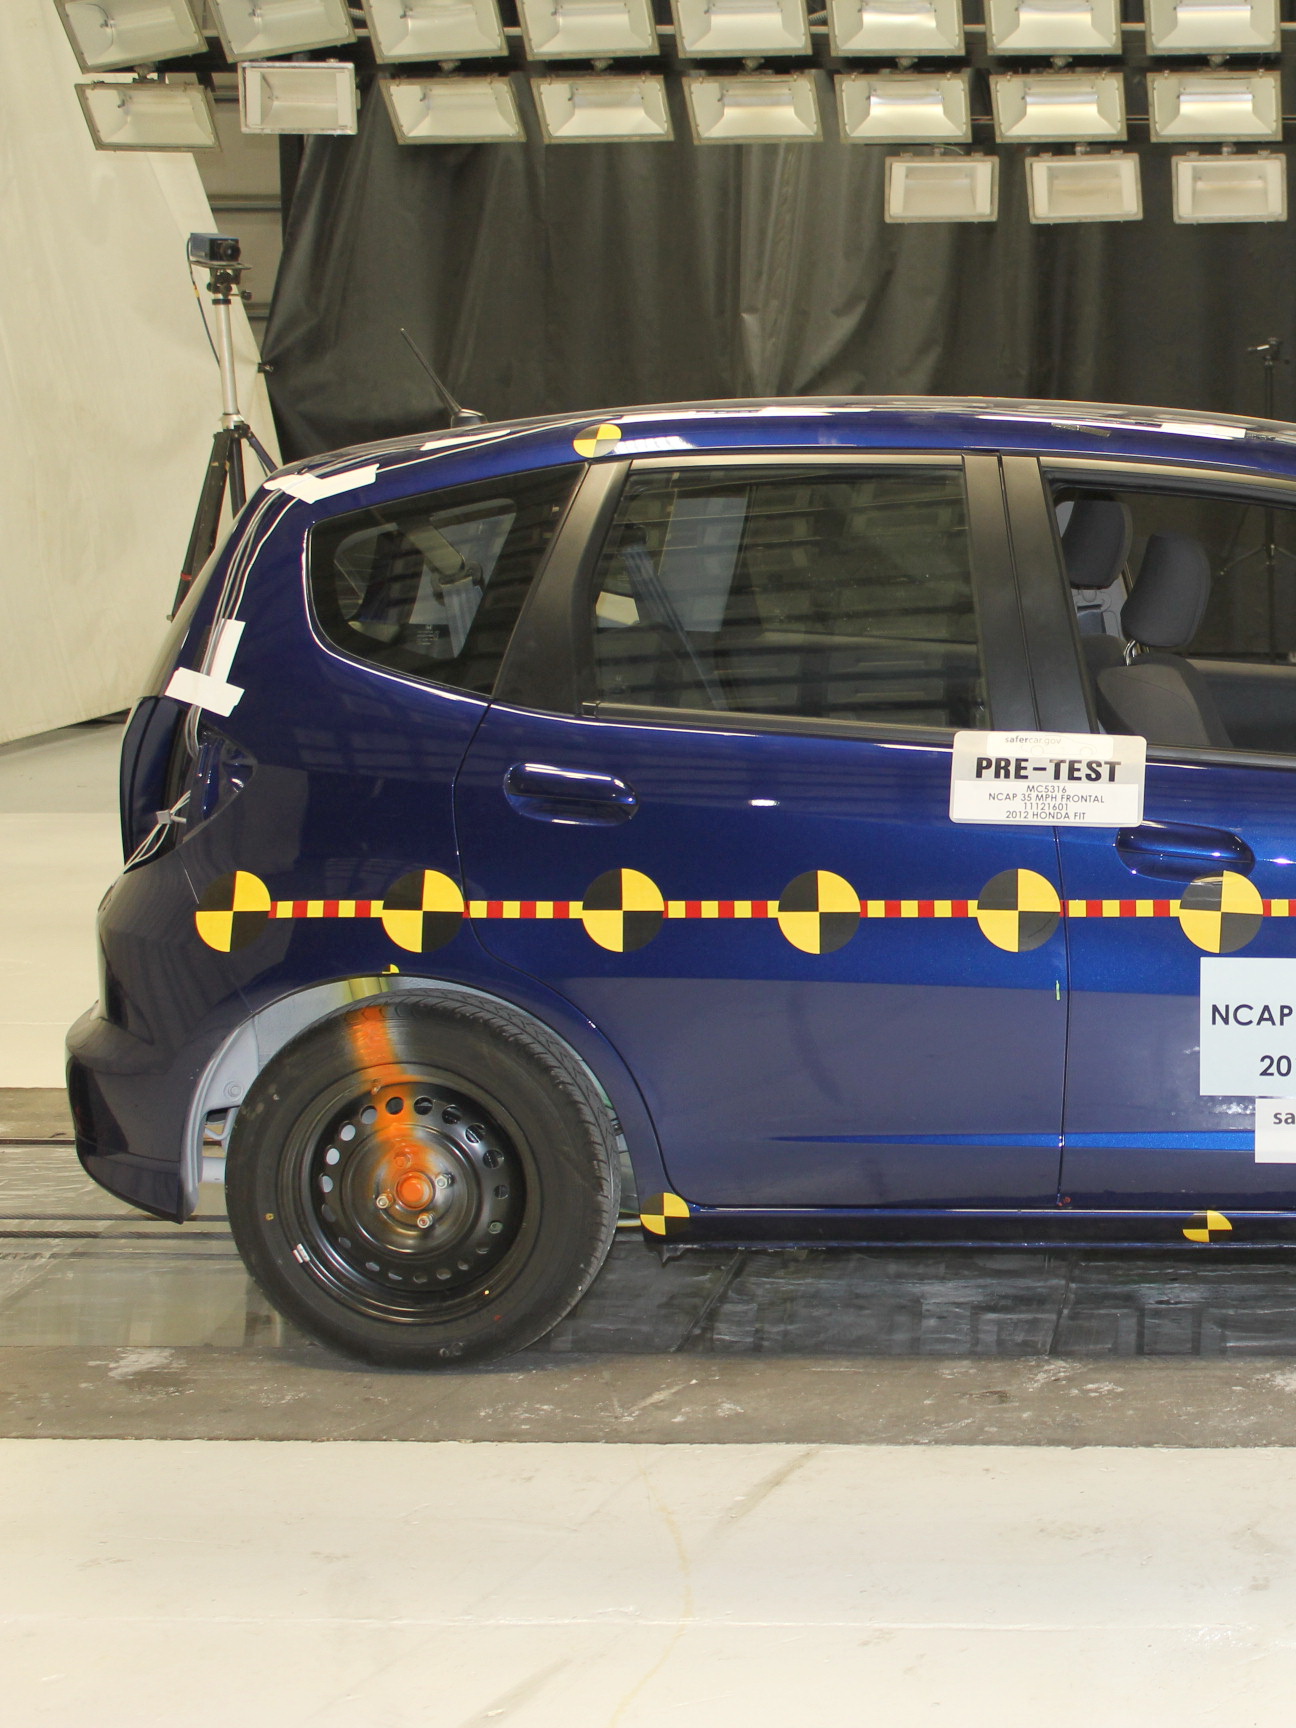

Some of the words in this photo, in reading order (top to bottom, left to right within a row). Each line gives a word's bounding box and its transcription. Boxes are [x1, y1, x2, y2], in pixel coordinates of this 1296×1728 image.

[1004, 735, 1062, 746] safercar.gov
[975, 757, 1122, 783] PRE-TEST
[1026, 784, 1068, 794] MC5316
[988, 793, 1018, 802] NCAP
[1020, 793, 1032, 802] 35
[1035, 793, 1058, 802] MPH
[1060, 794, 1105, 804] FRONTAL
[1023, 802, 1069, 812] 11121601
[1005, 810, 1029, 820] 2012
[1032, 811, 1071, 820] HONDA
[1073, 812, 1087, 821] FIT
[1211, 1004, 1293, 1026] NCAP
